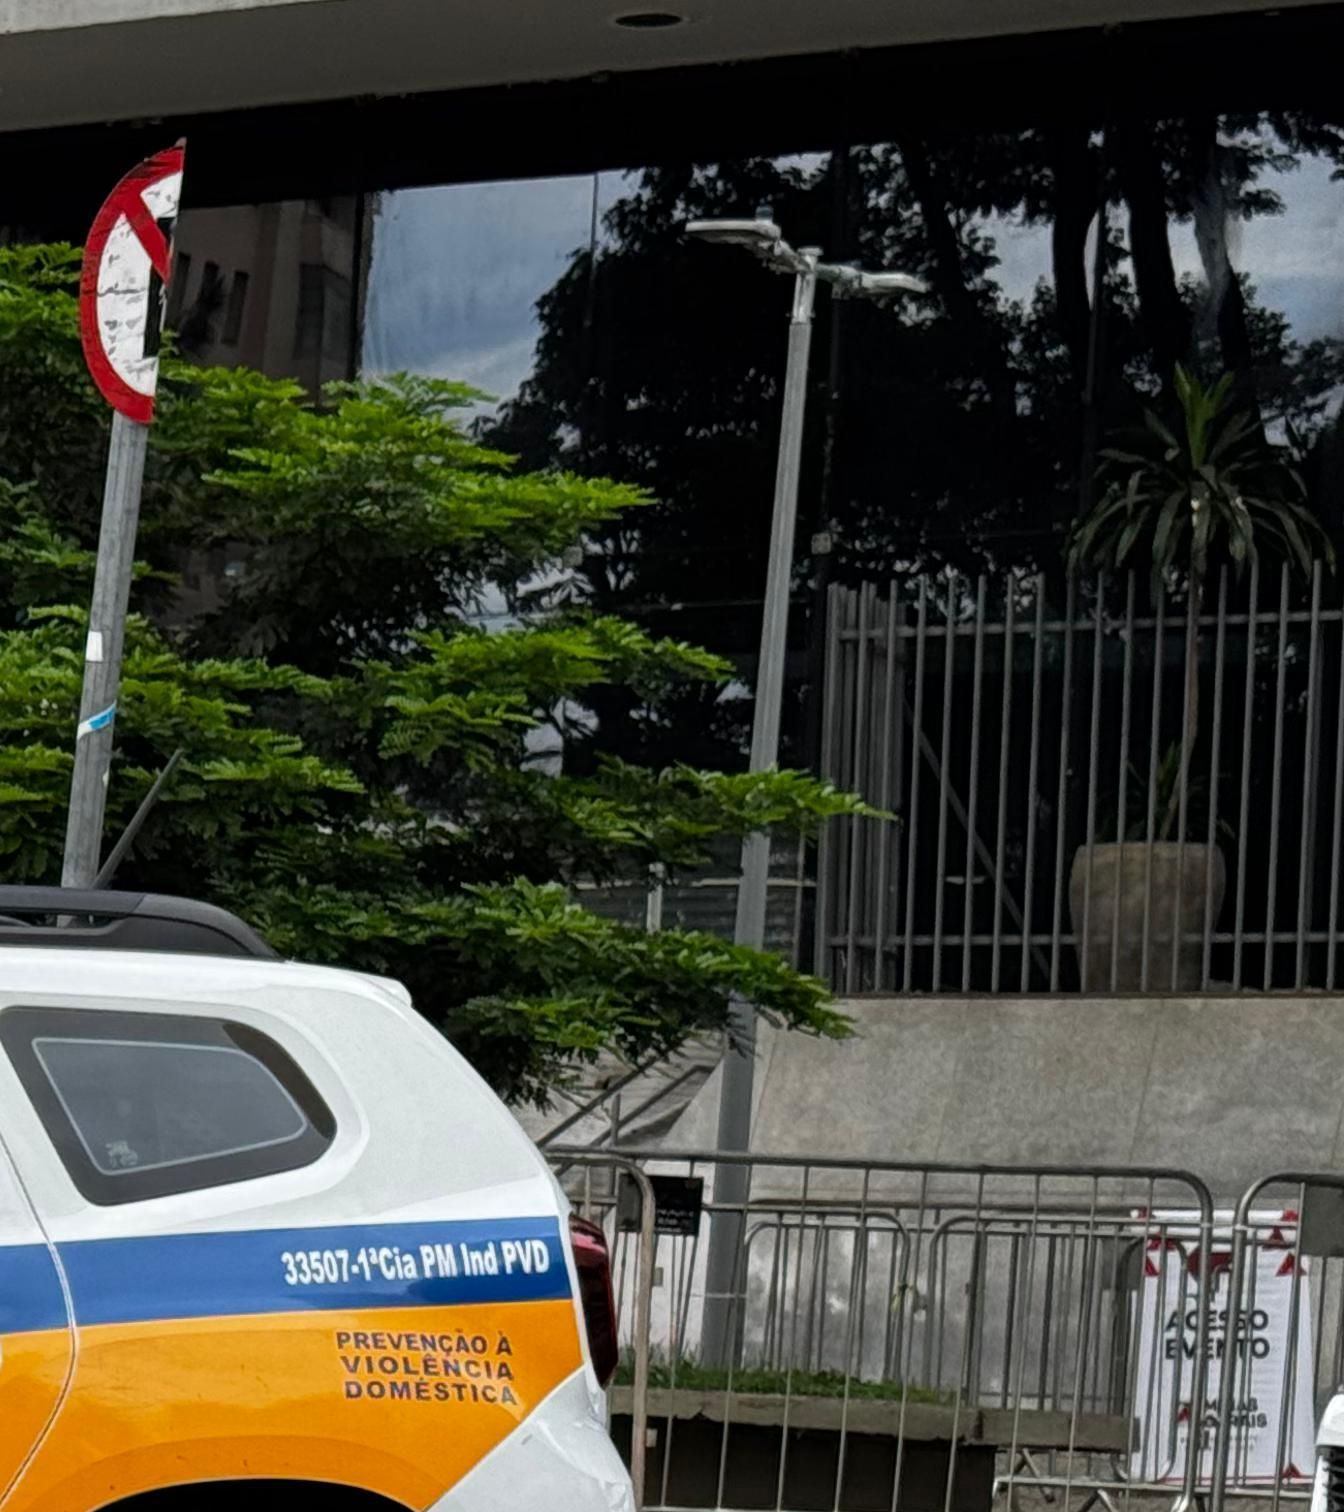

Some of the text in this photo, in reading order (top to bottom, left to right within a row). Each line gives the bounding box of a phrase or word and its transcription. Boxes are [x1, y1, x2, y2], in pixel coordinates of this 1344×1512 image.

[419, 1243, 458, 1278] PM
[461, 1241, 498, 1276] Ind
[502, 1239, 550, 1273] PVD
[335, 1329, 488, 1358] PREVENÇÃO
[341, 1354, 514, 1381] VIOLÊNCIA
[344, 1377, 518, 1406] DOMÉSTICA
